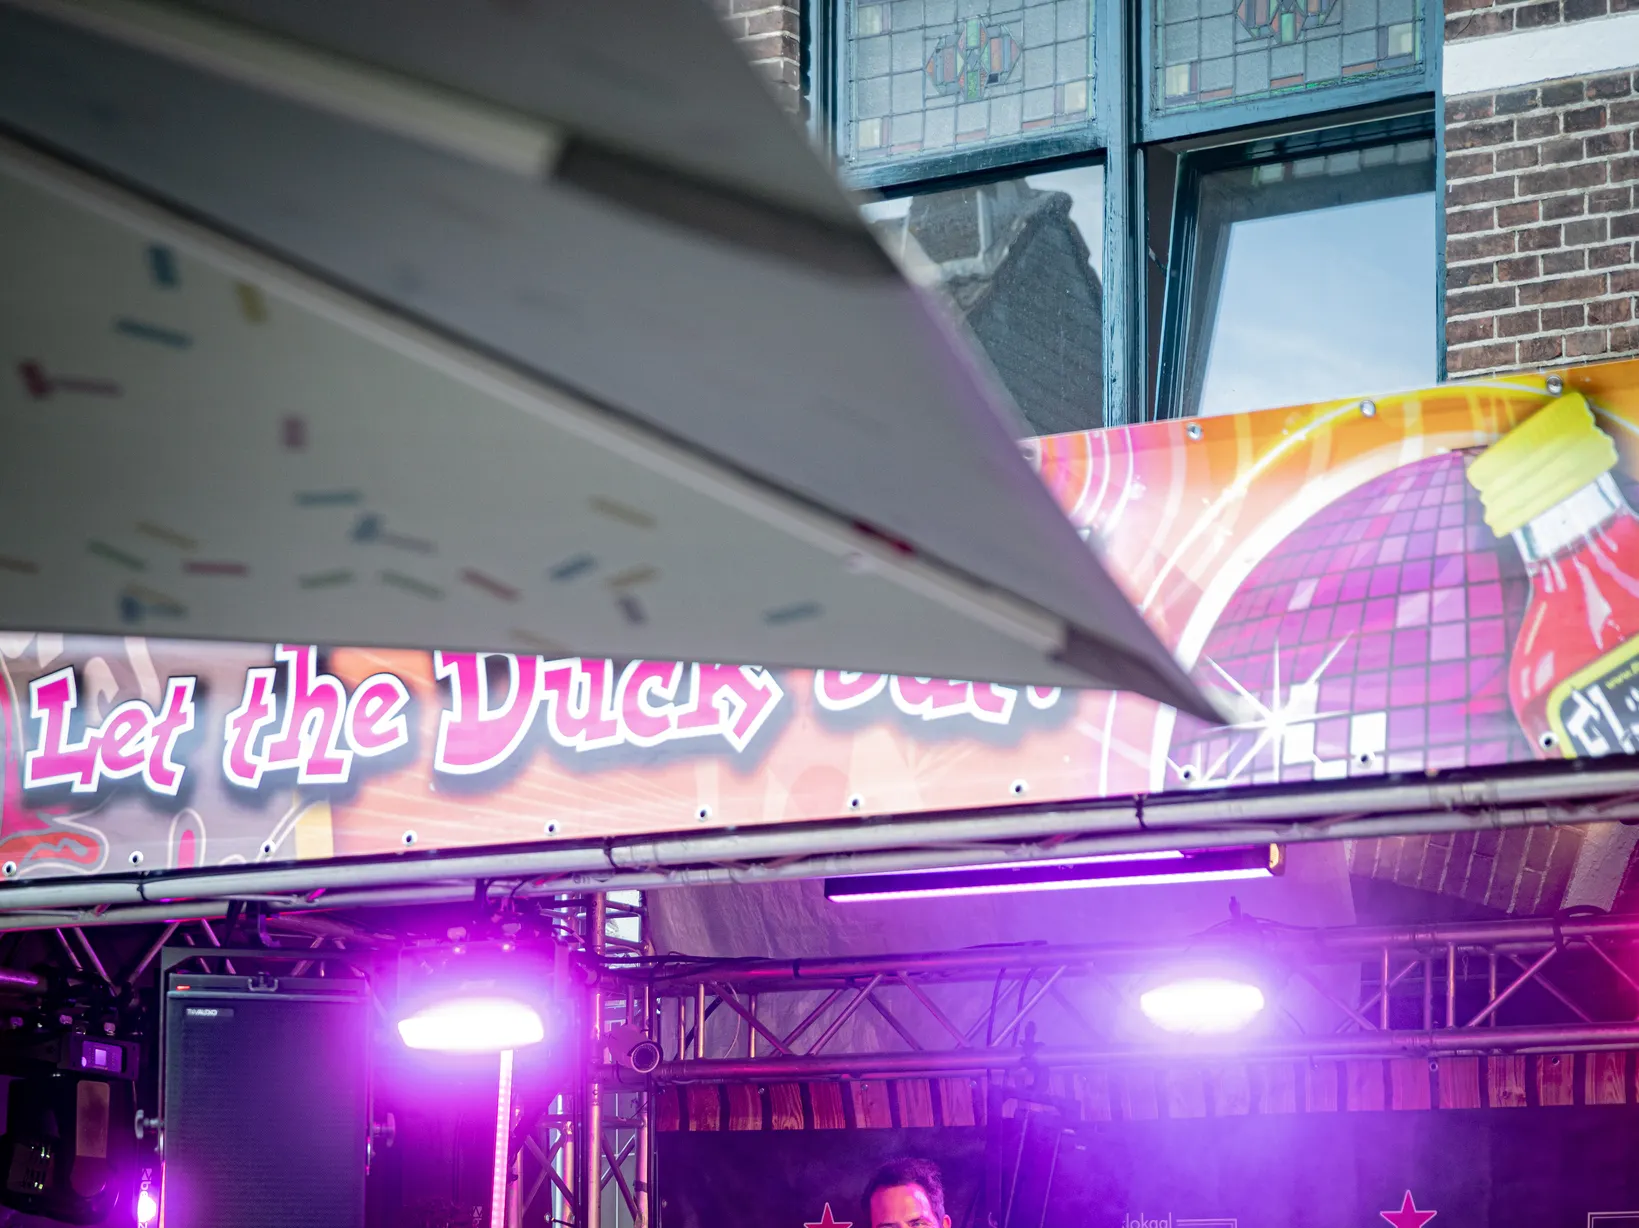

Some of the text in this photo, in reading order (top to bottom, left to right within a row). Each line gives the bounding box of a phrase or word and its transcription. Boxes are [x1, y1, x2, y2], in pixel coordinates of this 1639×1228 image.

[24, 665, 197, 796] Let
[223, 643, 411, 788] the
[433, 650, 784, 775] Duck
